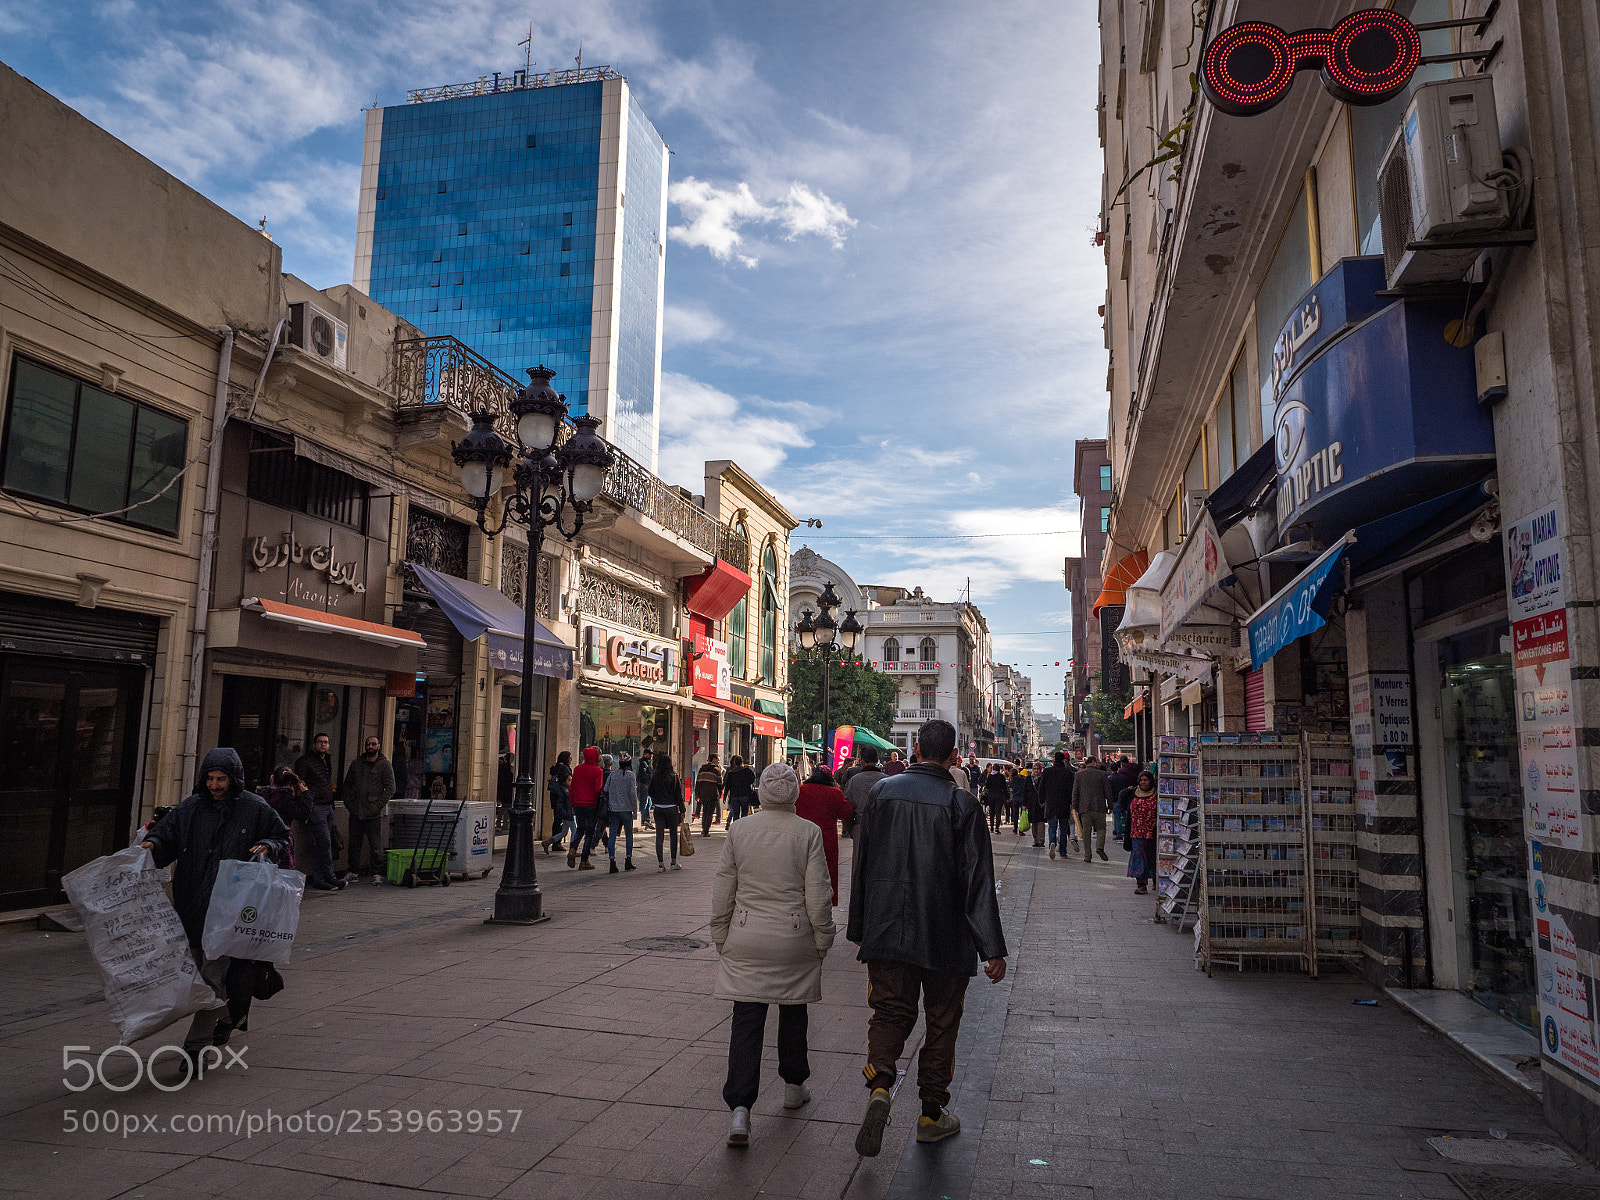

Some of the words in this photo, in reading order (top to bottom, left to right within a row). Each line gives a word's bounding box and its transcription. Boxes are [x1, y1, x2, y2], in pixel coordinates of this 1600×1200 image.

[1296, 441, 1344, 506] OPTIC
[1531, 509, 1558, 546] MARIAM
[252, 530, 304, 573] ناوري
[311, 545, 366, 594] حلويات
[1534, 553, 1560, 587] OPTIQUE
[1531, 614, 1563, 638] متعاقد
[1168, 630, 1229, 646] onseigneur
[1516, 628, 1528, 649] مع
[1552, 640, 1566, 653] AVEC
[609, 635, 664, 682] Cadence
[388, 687, 413, 697] orange
[1374, 677, 1403, 690] Monture
[1379, 695, 1384, 707] 2
[1385, 695, 1408, 707] Verres
[1379, 713, 1410, 728] Optiques
[1383, 731, 1388, 743] à
[1389, 731, 1399, 743] 80
[1401, 731, 1409, 743] Dt
[474, 815, 488, 835] ثلج
[233, 925, 256, 936] YVES
[259, 929, 294, 941] ROCHER
